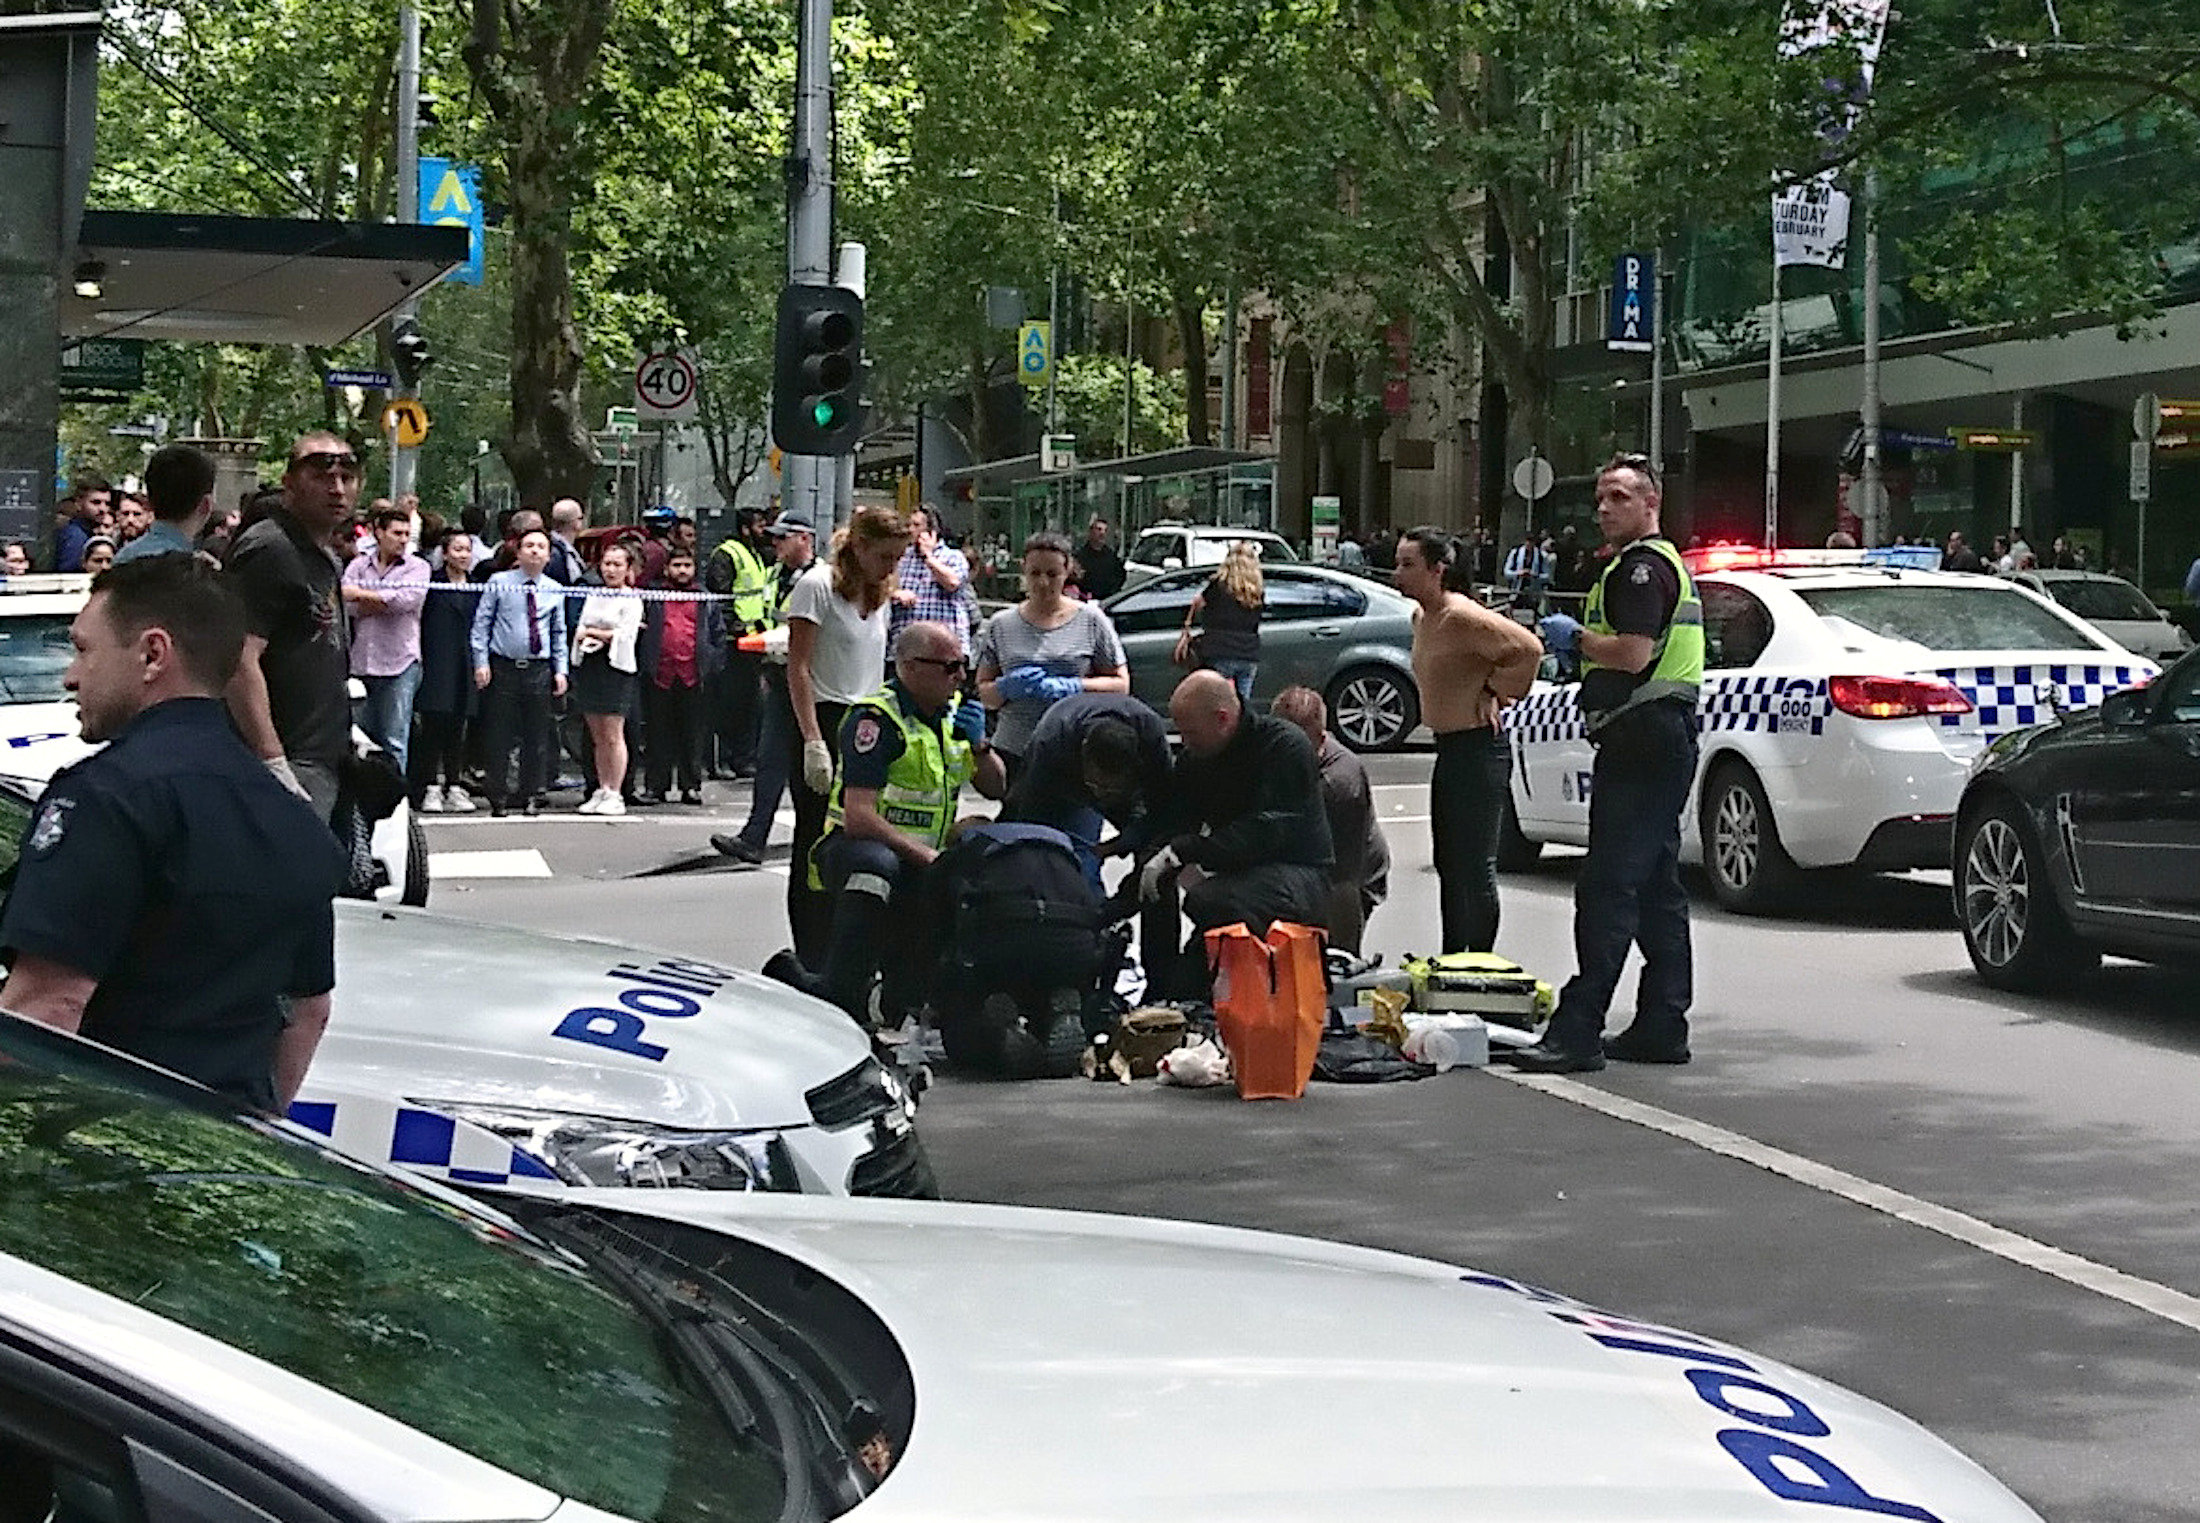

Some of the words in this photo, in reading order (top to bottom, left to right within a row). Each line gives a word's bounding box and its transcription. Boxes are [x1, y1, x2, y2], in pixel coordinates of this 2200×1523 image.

[1623, 256, 1641, 339] DRAMA
[642, 367, 687, 396] 40
[1780, 699, 1812, 717] 000
[886, 807, 932, 827] HEALTH
